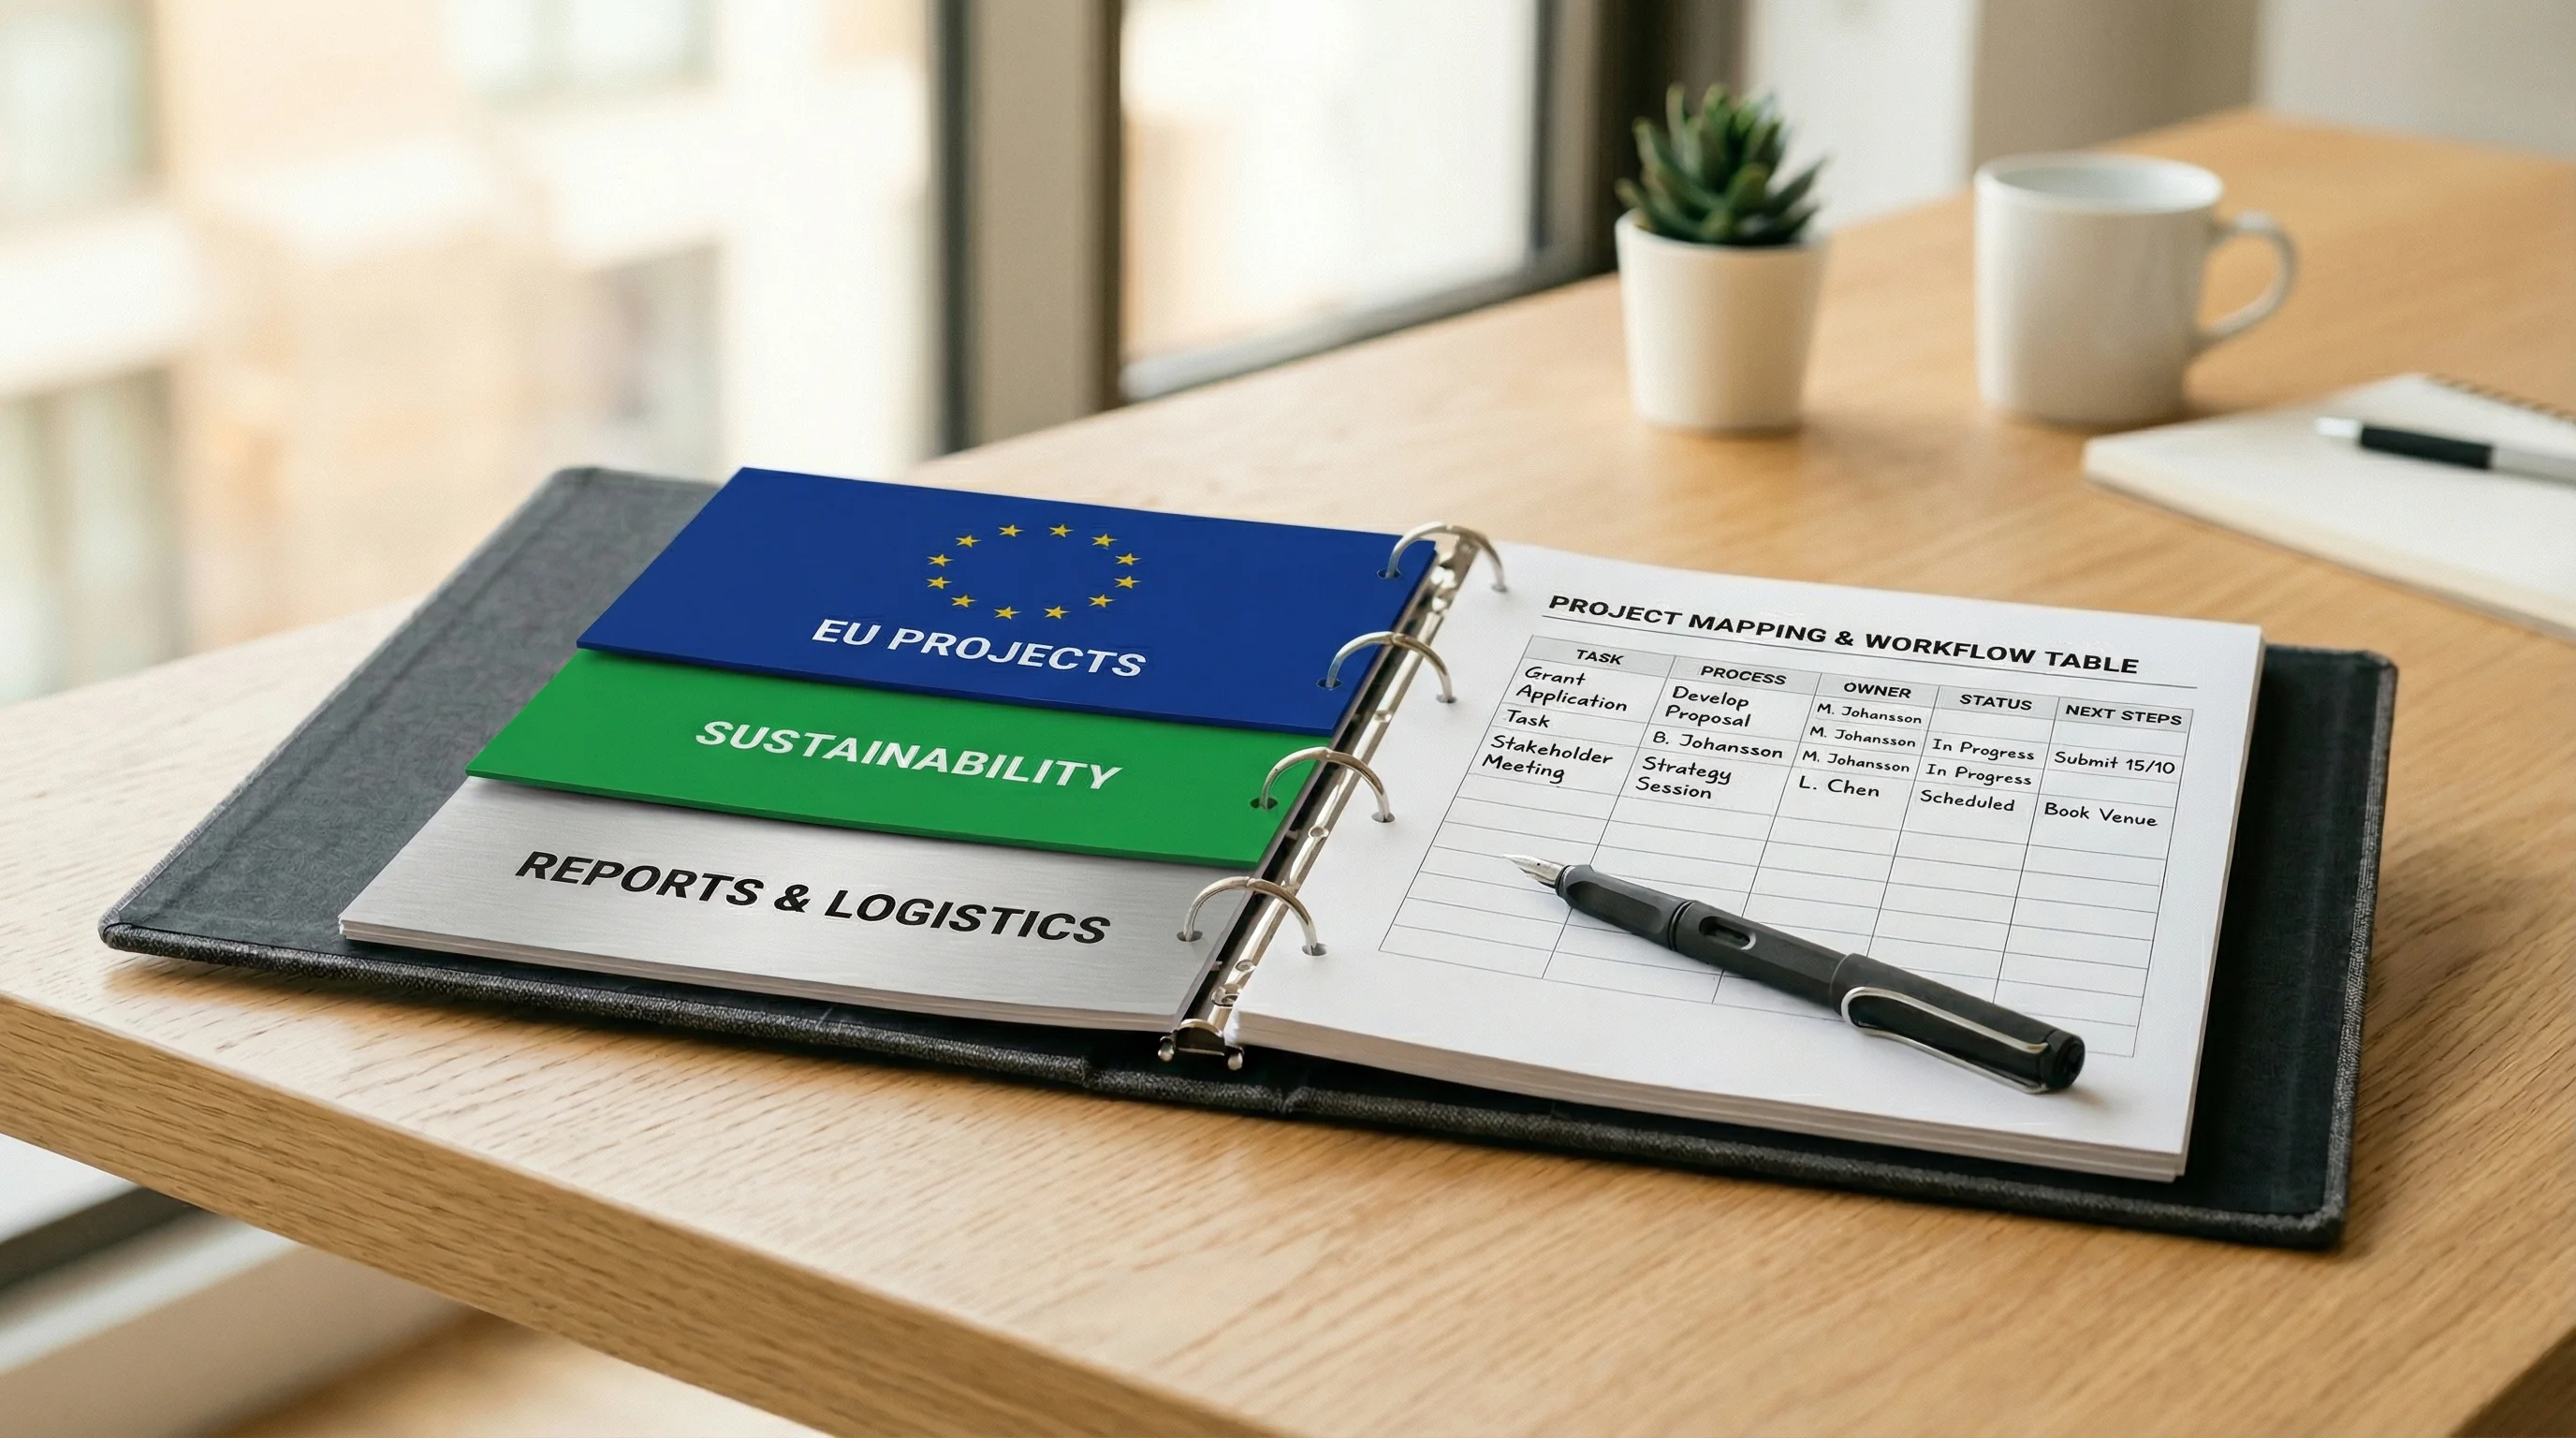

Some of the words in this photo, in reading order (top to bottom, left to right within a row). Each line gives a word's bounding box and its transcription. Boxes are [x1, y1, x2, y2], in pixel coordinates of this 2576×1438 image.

[1548, 594, 1683, 626] PROJECT
[1688, 613, 1827, 643] MAPPING
[1834, 630, 1854, 647] &
[1866, 633, 2037, 664] WORKFLOW
[2044, 651, 2140, 674] TABLE
[812, 618, 882, 646] EU
[887, 627, 1147, 677] PROJECTS
[1576, 649, 1624, 666] TASK
[1525, 666, 1586, 686] Grant
[1700, 665, 1787, 685] PROCESS
[1515, 683, 1628, 712] Application
[1672, 685, 1749, 709] Develop
[1843, 682, 1911, 699] OWNER
[1817, 702, 1835, 714] M.
[1841, 706, 1922, 725] Johansson
[1959, 694, 2033, 711] STATUS
[1507, 709, 1550, 728] Task
[1664, 704, 1751, 727] Proposal
[2065, 704, 2116, 719] NEXT
[2120, 710, 2182, 726] STEPS
[1652, 730, 1670, 743] B.
[1678, 733, 1783, 759] Johansson
[1809, 726, 1827, 738] M.
[1834, 728, 1916, 748] Johansson
[695, 721, 1123, 789] SUSTAINABILITY
[1490, 734, 1614, 765] Stakeholder
[1802, 750, 1821, 762] M.
[1826, 753, 1910, 772] Johansson
[1932, 738, 1953, 752] In
[1959, 741, 2035, 761] Progress
[1482, 754, 1565, 785] Meeting
[1642, 756, 1732, 785] Strategy
[1925, 763, 1947, 777] In
[1954, 766, 2032, 786] Progress
[2054, 751, 2119, 769] Submit
[2125, 758, 2175, 775] 15/10
[1635, 776, 1712, 800] Session
[1798, 775, 1817, 790] L.
[1827, 778, 1880, 798] Chen
[1920, 789, 2015, 812] Scheduled
[2043, 801, 2089, 820] Book
[2099, 808, 2159, 827] Venue
[514, 850, 765, 906] REPORTS
[773, 884, 811, 914] &
[824, 889, 1111, 945] LOGISTICS
